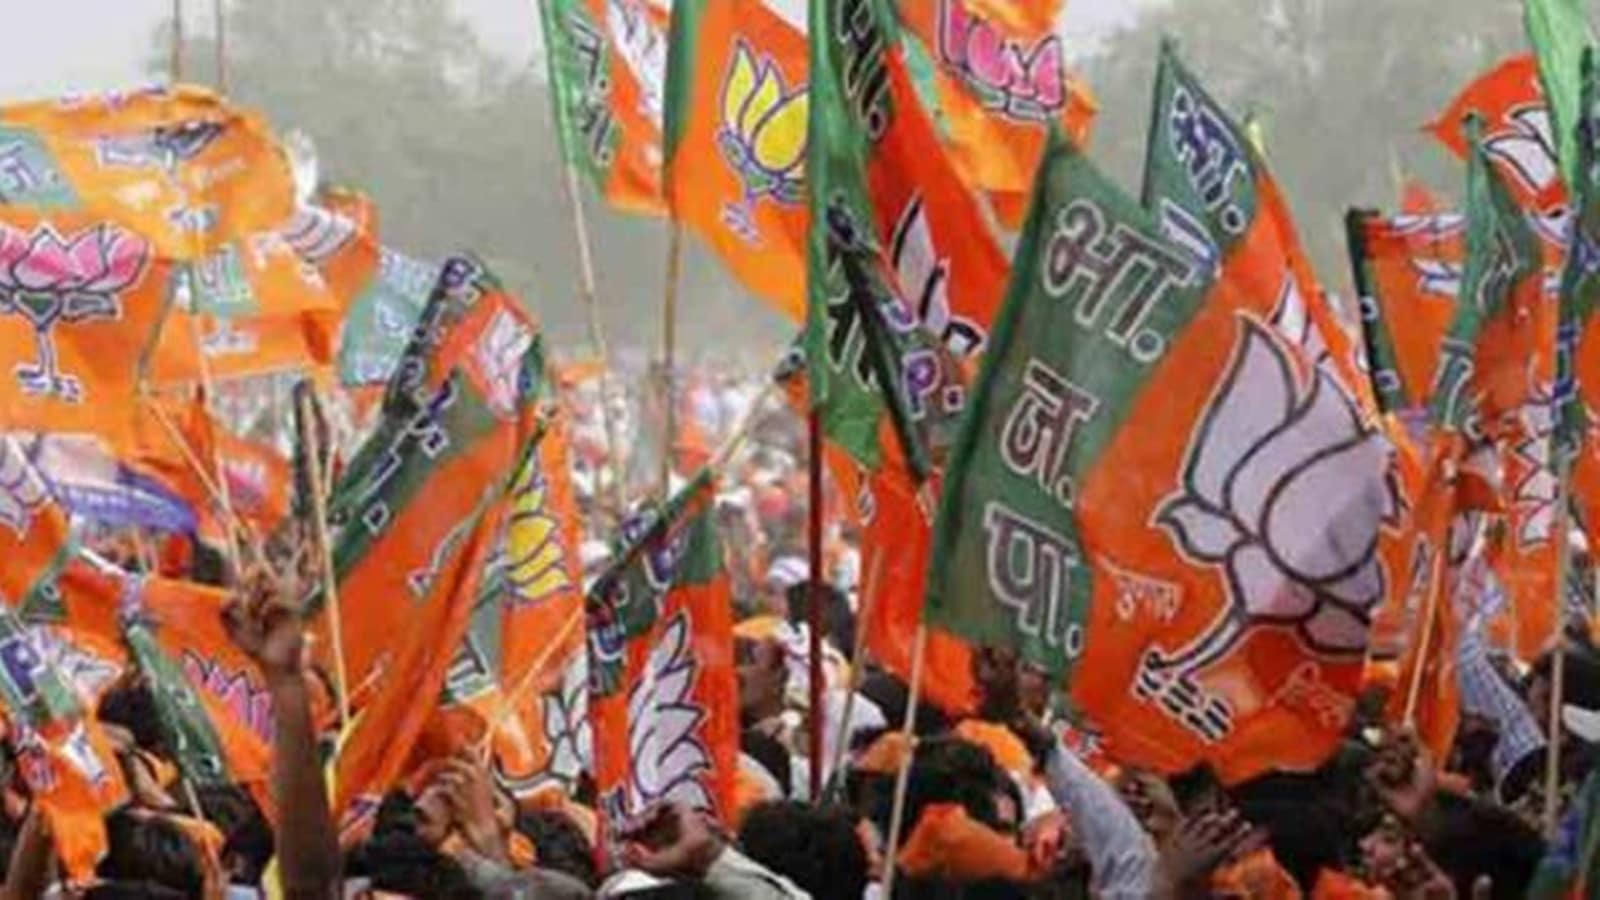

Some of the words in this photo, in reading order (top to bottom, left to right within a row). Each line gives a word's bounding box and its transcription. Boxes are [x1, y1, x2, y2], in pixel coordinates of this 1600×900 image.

[1043, 199, 1192, 362] भा.
[1001, 356, 1099, 509] ज.
[983, 501, 1084, 658] पा.
